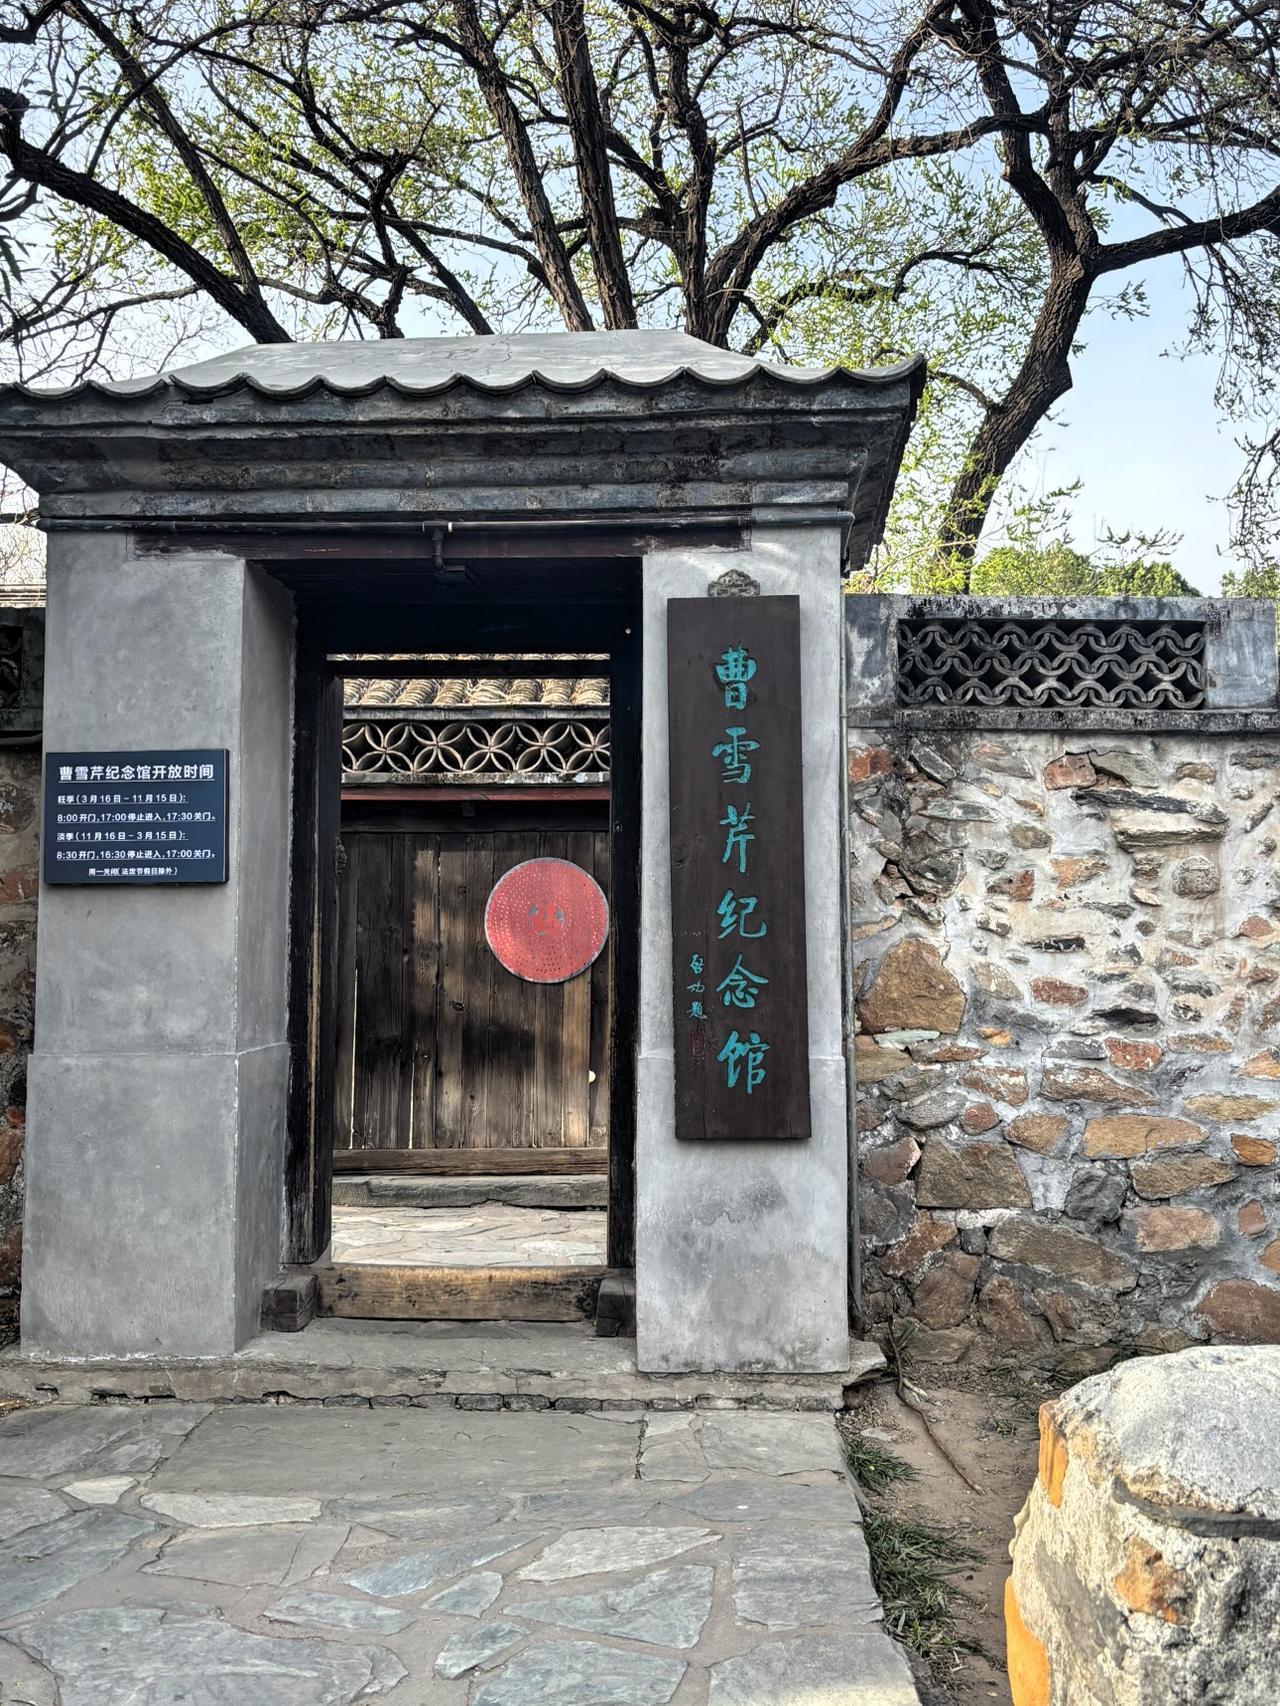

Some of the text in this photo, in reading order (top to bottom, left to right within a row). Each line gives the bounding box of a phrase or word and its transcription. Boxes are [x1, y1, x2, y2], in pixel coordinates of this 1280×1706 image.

[58, 764, 215, 781] 曹雪芹纪念馆开放时间
[711, 644, 770, 1094] 曹雪芹纪念馆
